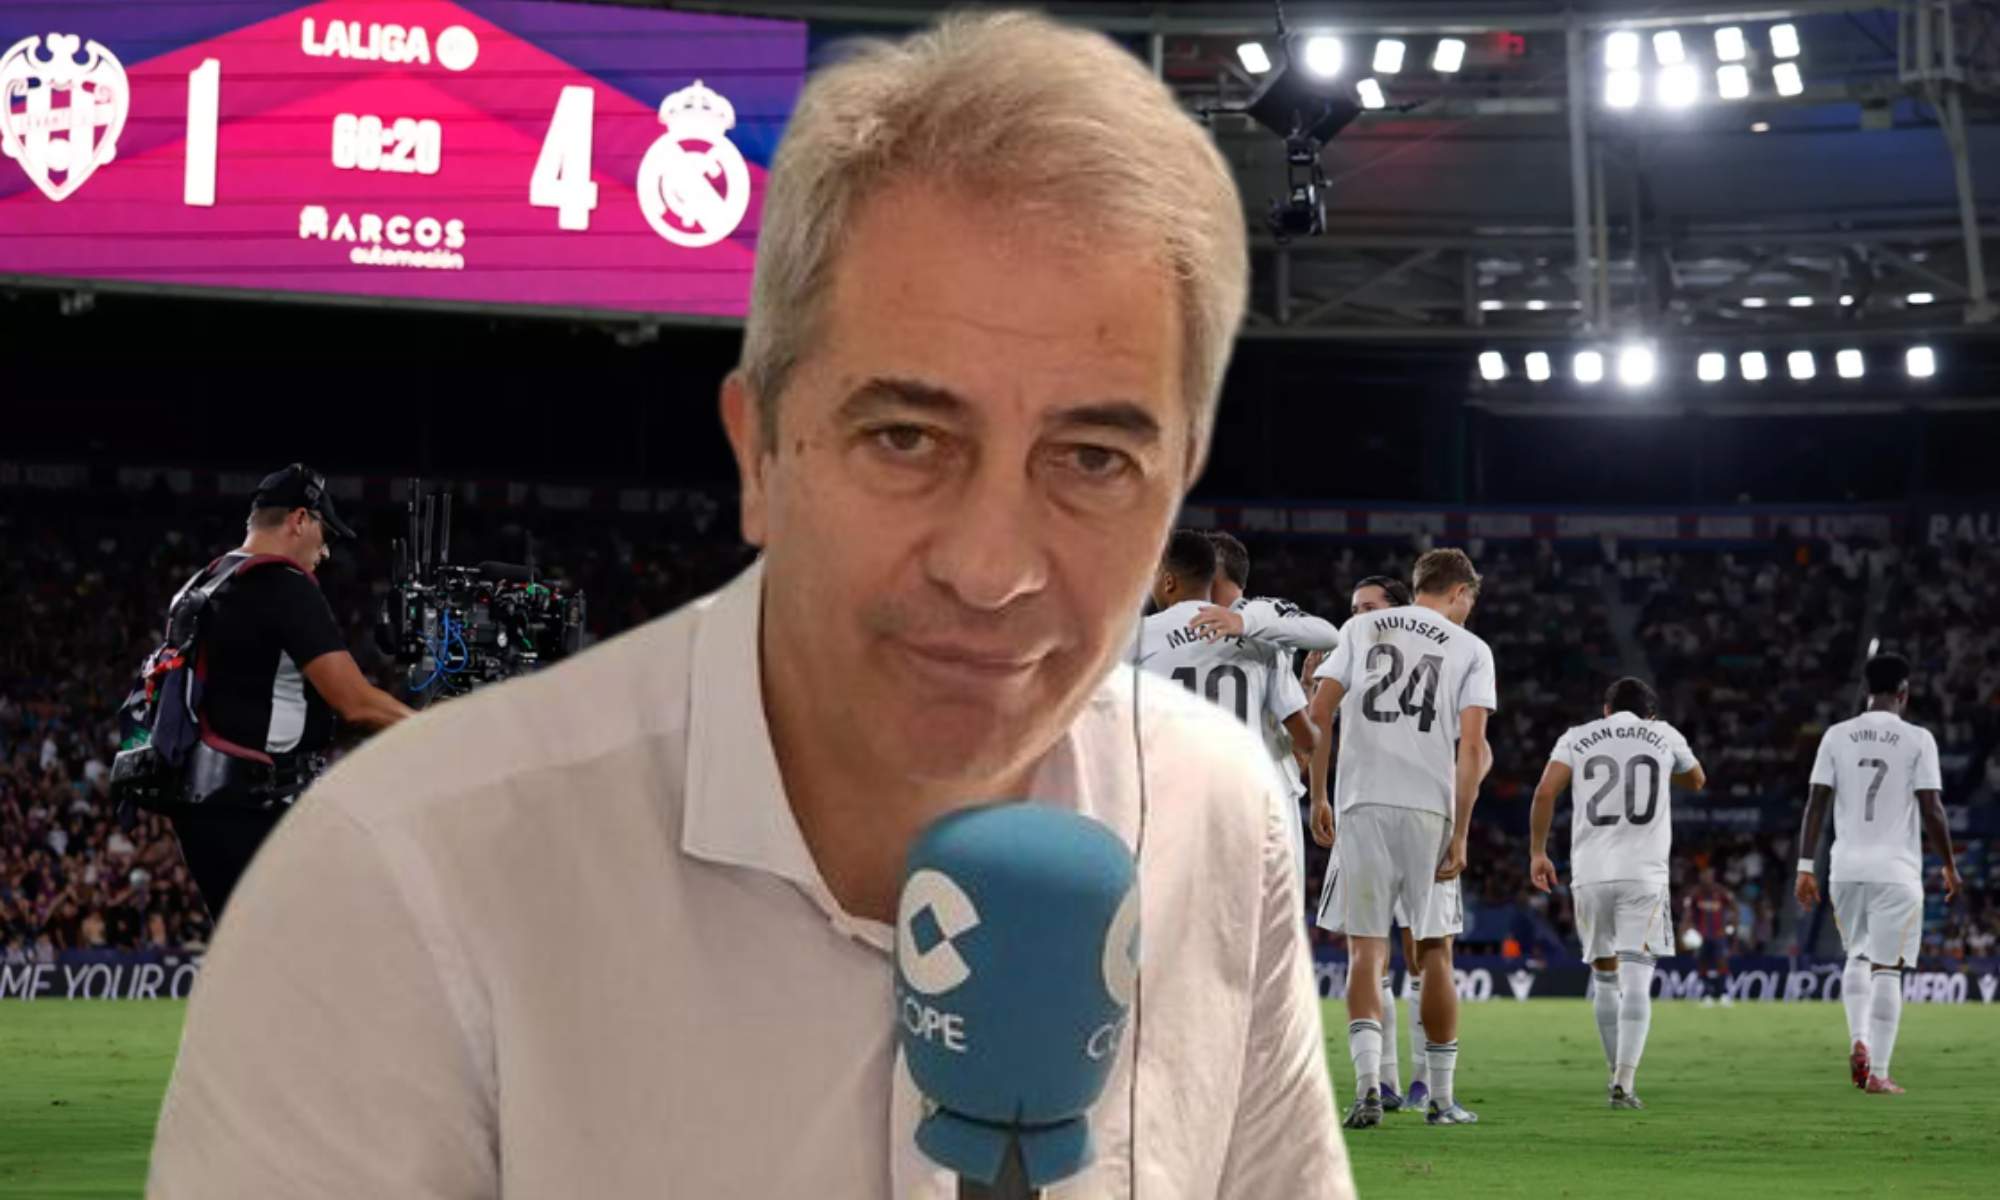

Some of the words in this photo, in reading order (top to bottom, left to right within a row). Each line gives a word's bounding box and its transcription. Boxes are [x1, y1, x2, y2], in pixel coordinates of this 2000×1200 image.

[302, 17, 431, 64] LALIGA
[184, 59, 220, 206] 1
[529, 85, 598, 231] 4
[299, 205, 466, 249] MARCOS
[1374, 616, 1450, 645] HUIJSEN
[1362, 643, 1444, 733] 24
[1573, 727, 1613, 754] FRAN
[1849, 730, 1877, 743] VINI
[1584, 754, 1659, 826] 20
[1858, 758, 1888, 822] 7
[64, 963, 164, 1000] YOUR
[1902, 971, 1968, 1001] HERO
[900, 994, 967, 1052] OPE
